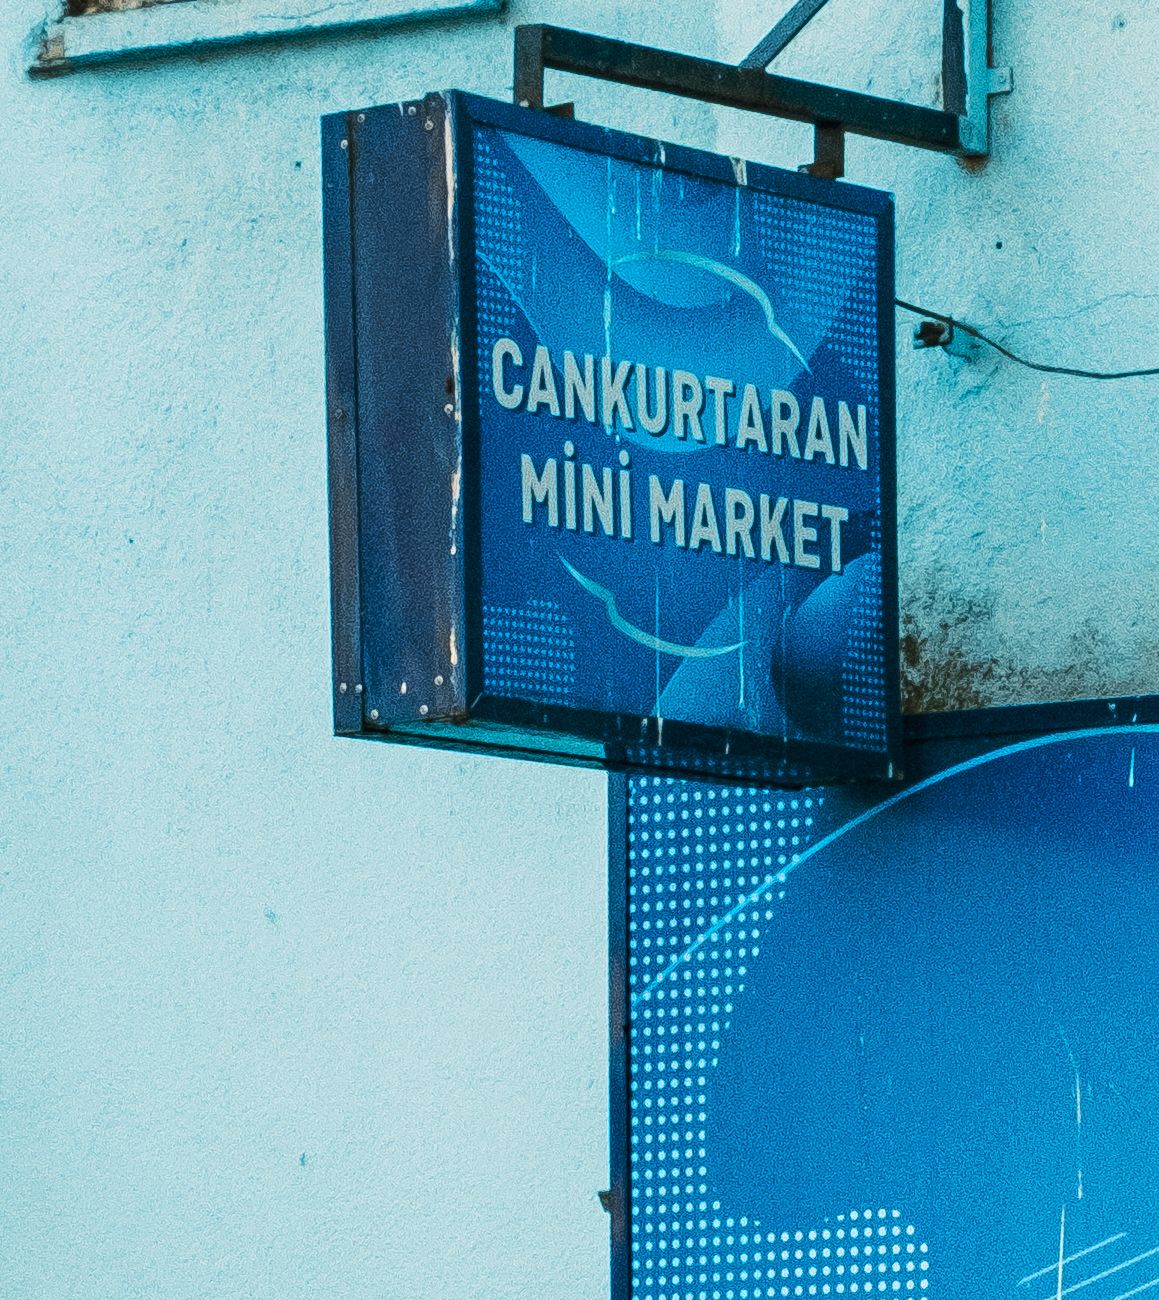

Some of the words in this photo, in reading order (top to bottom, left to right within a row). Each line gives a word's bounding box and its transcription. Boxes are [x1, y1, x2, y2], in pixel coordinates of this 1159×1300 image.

[491, 338, 868, 470] CANKURTARAN
[520, 440, 632, 540] MİNİ
[649, 476, 849, 573] MARKET
